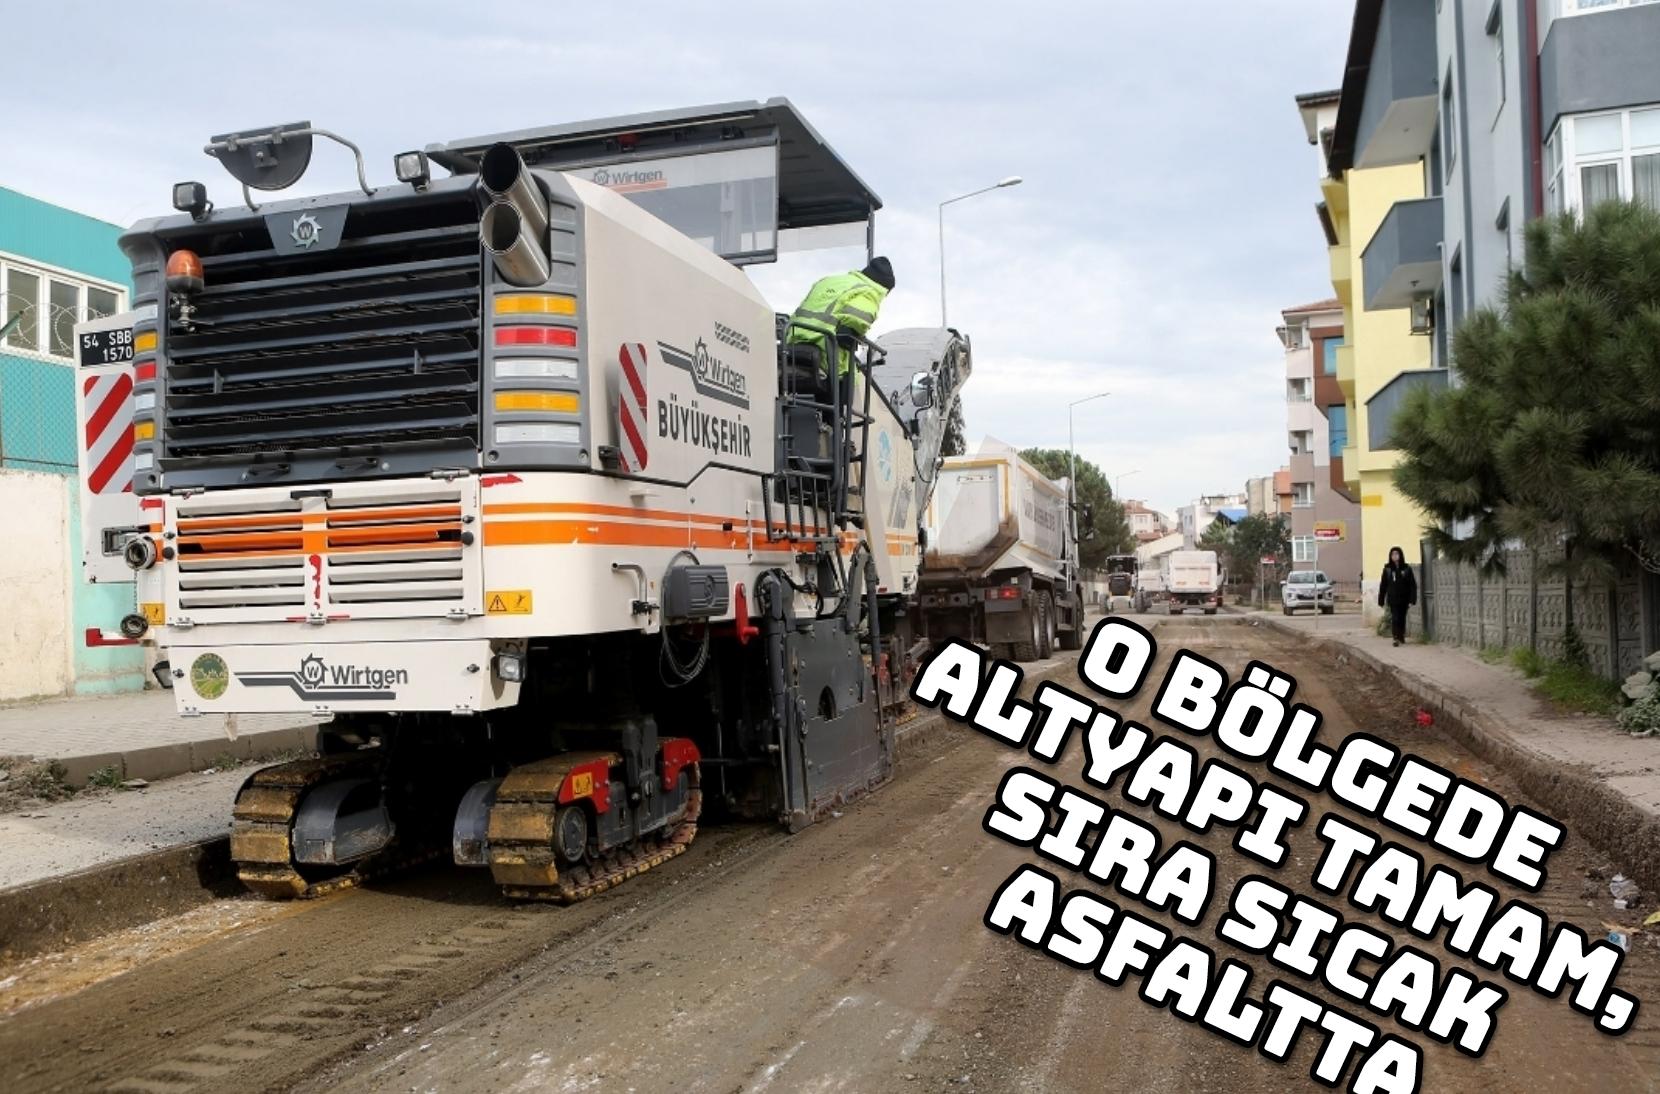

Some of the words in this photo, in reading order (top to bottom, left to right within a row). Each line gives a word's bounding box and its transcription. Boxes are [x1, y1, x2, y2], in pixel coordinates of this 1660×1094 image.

[612, 169, 663, 185] Wirtgen
[83, 334, 99, 348] 54
[108, 330, 132, 346] SBB
[102, 346, 133, 361] 1570
[709, 356, 746, 392] Wirtgen
[658, 392, 752, 458] BÜYÜKŞEHİR
[330, 664, 408, 689] Wirtgen
